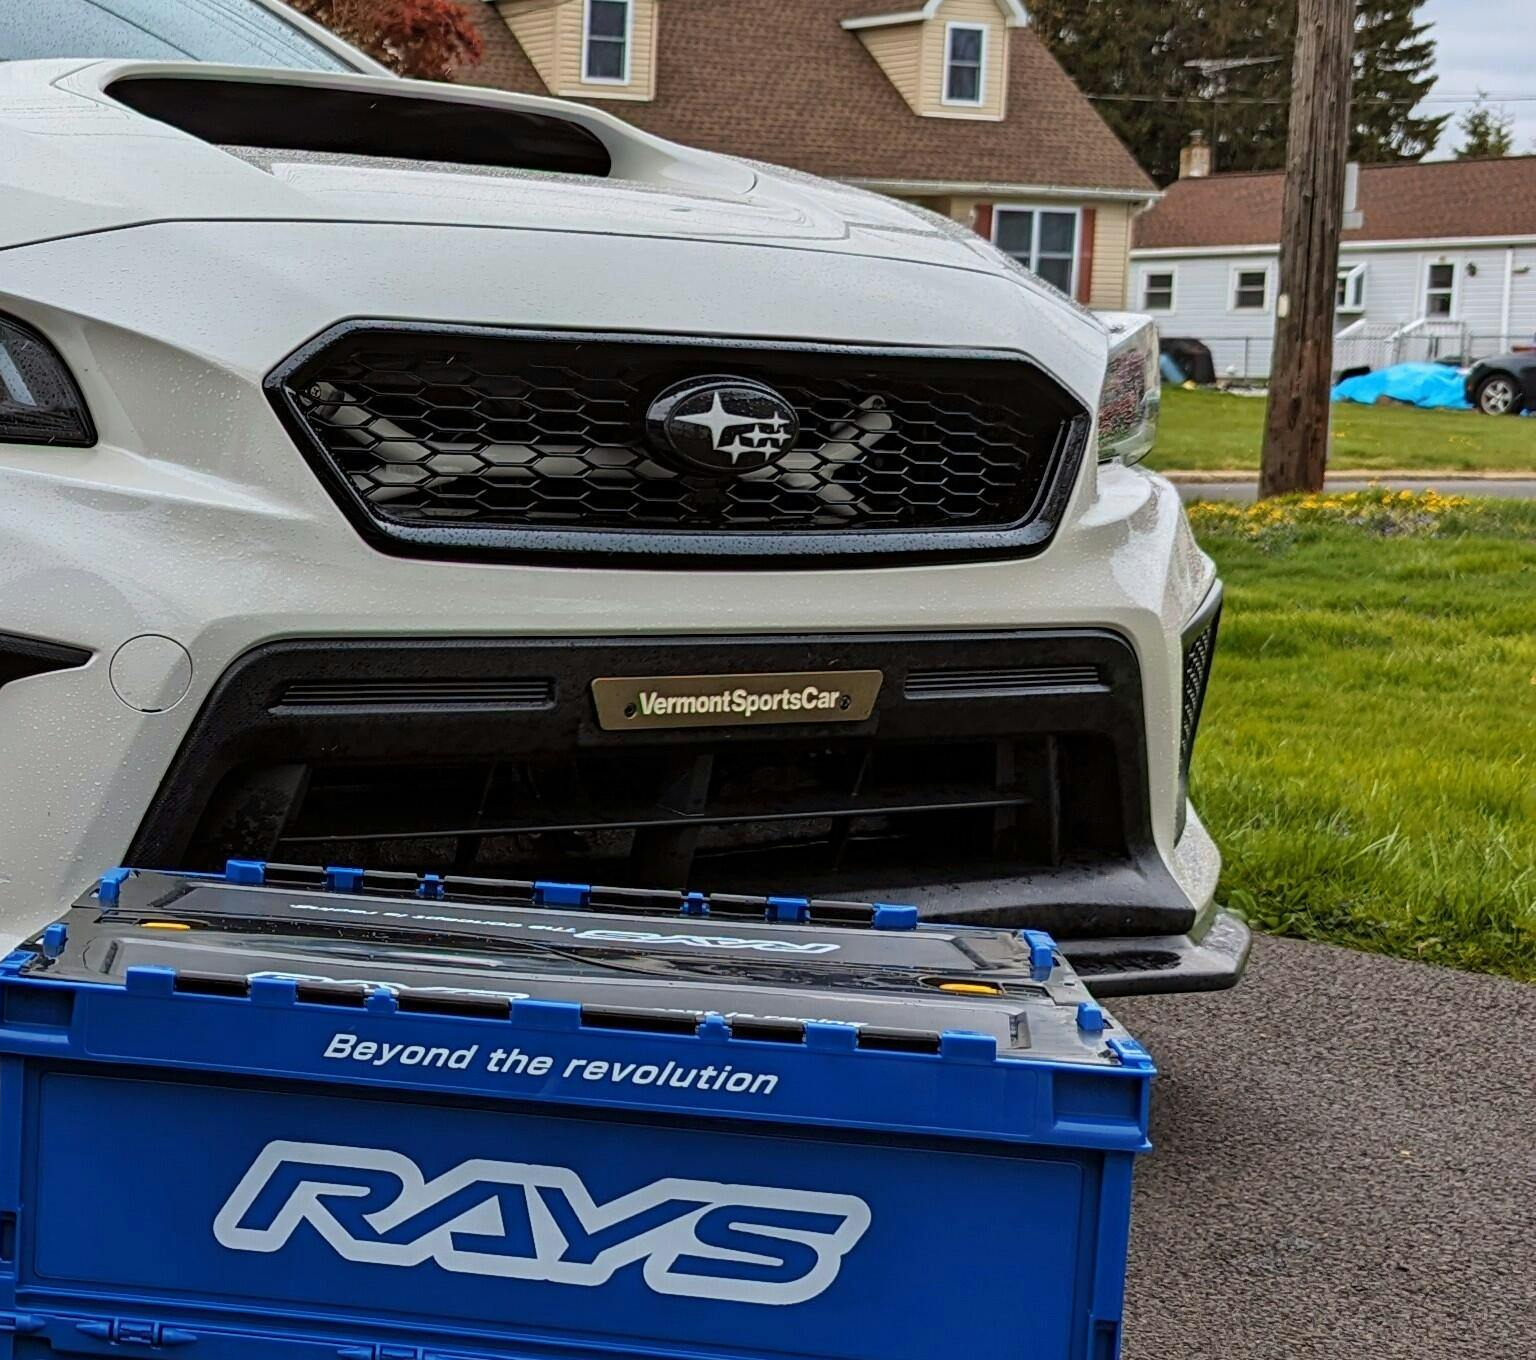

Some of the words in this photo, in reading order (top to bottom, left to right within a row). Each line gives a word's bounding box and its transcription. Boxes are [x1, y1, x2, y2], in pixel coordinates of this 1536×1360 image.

[639, 687, 839, 716] VermontSportsCar
[572, 929, 841, 954] RAYS
[323, 1033, 478, 1069] Beyond
[485, 1048, 554, 1075] the
[562, 1058, 779, 1095] revolution
[213, 1139, 872, 1306] RAYS
